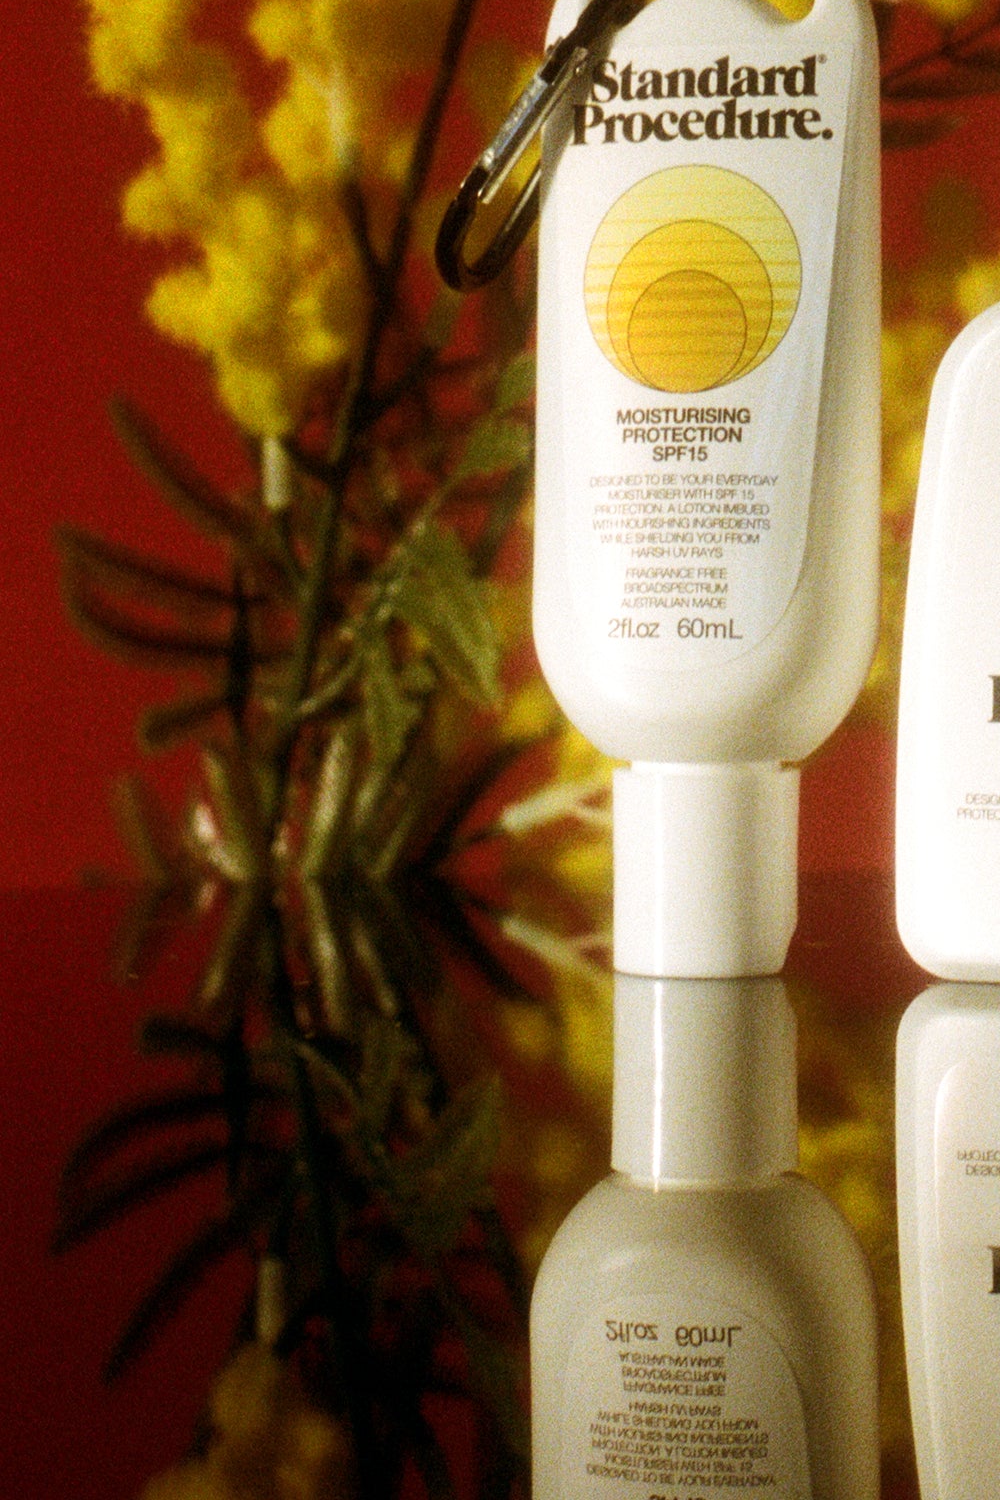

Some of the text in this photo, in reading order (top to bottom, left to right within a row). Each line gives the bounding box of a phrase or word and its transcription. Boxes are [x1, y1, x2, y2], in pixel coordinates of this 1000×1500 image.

[572, 98, 833, 145] Procedure.
[616, 407, 751, 425] MOISTURISING
[622, 427, 742, 443] PROTECTION
[653, 446, 708, 462] SPF15
[608, 618, 743, 639] 2fl.oz 60mL
